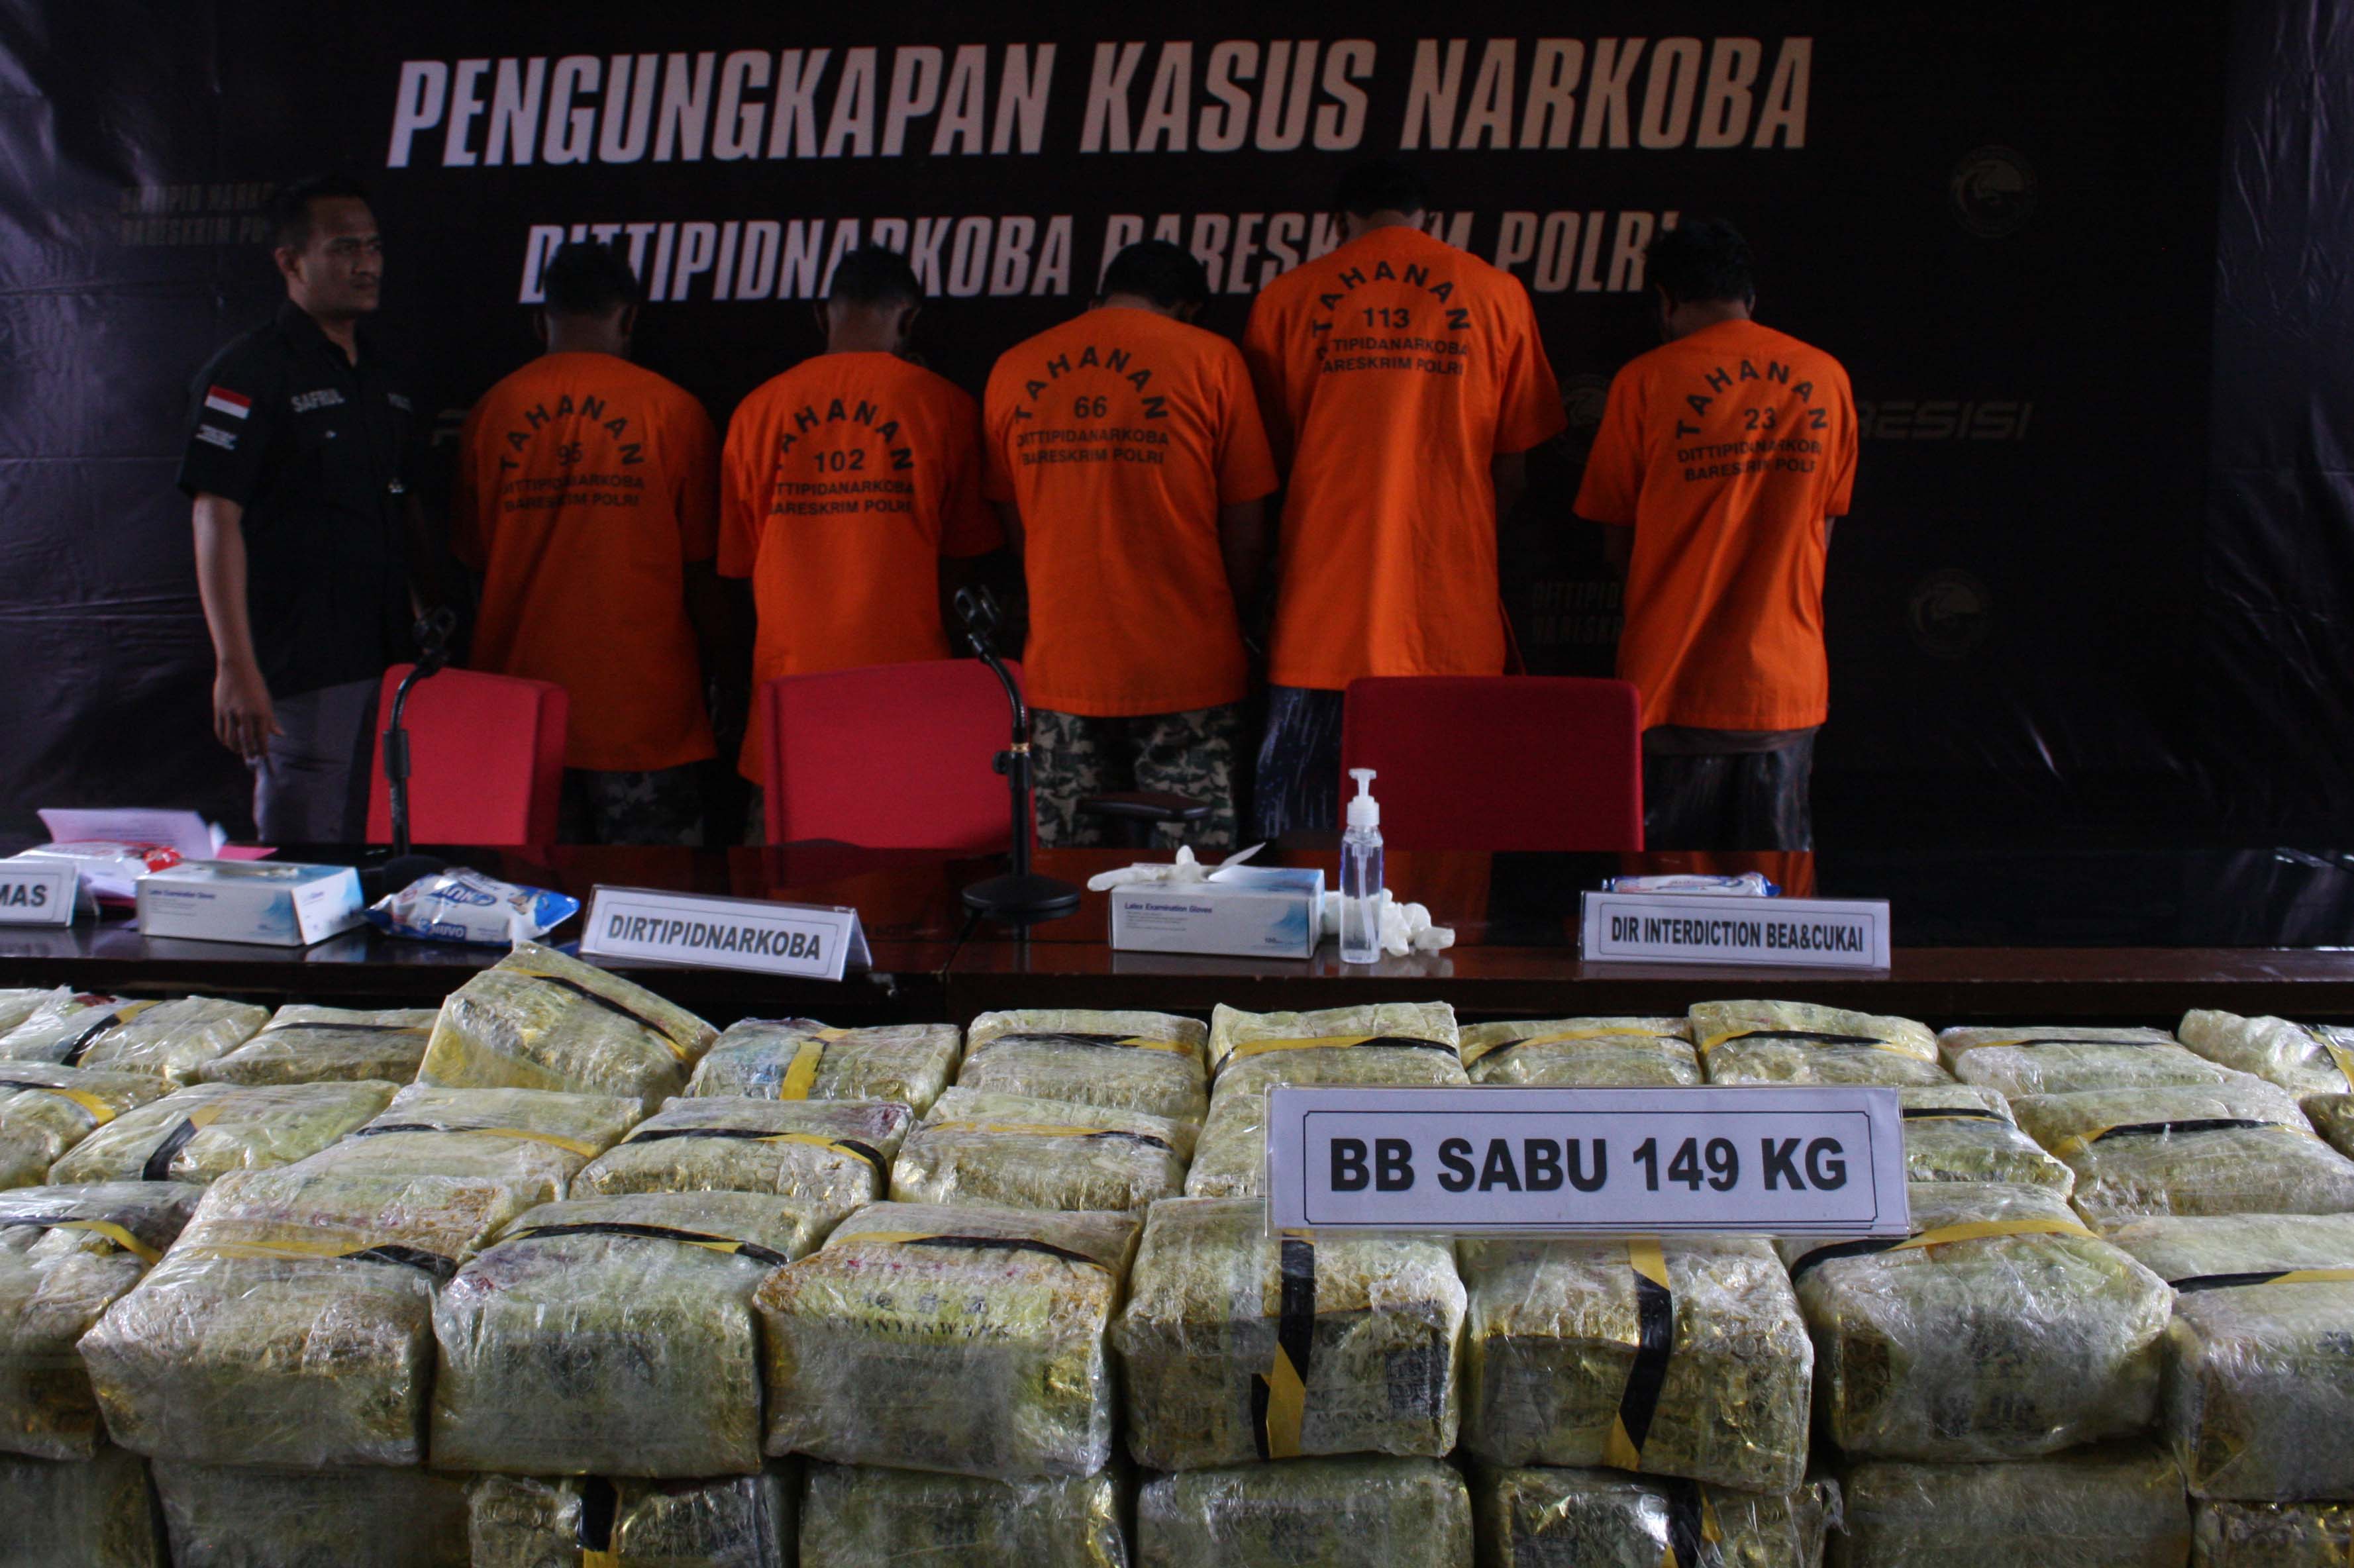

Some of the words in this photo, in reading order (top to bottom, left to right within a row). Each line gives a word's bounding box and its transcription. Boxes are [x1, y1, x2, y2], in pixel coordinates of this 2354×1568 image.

[387, 44, 1057, 168] PENGUNGKAPAN
[1080, 40, 1376, 152] KASUS
[1400, 36, 1814, 150] NARKOBA
[1494, 210, 1680, 294] POLR
[1311, 261, 1470, 336] TAHANAN
[1363, 307, 1409, 329] 113
[1015, 346, 1168, 423] TAHANAN
[1323, 357, 1411, 373] ARESKRIM
[1074, 396, 1107, 418] 66
[1676, 360, 1827, 439] TAHANAN
[1744, 407, 1776, 430] 23
[499, 395, 644, 471] TAHANAN
[774, 399, 913, 470] AHANAN
[1113, 448, 1164, 464] POLRI
[814, 448, 864, 473] 102
[770, 501, 859, 515] ARESKRIM
[607, 914, 821, 961] DIRTIPIDNARKOBA
[1611, 916, 1639, 943] DIR
[1644, 917, 1762, 948] INTERDICTION
[1766, 922, 1863, 952] BEA&CUKAI
[1330, 1138, 1415, 1192] BB
[1437, 1138, 1607, 1192] SABU
[1633, 1137, 1739, 1192] 149
[1762, 1137, 1847, 1191] KG
